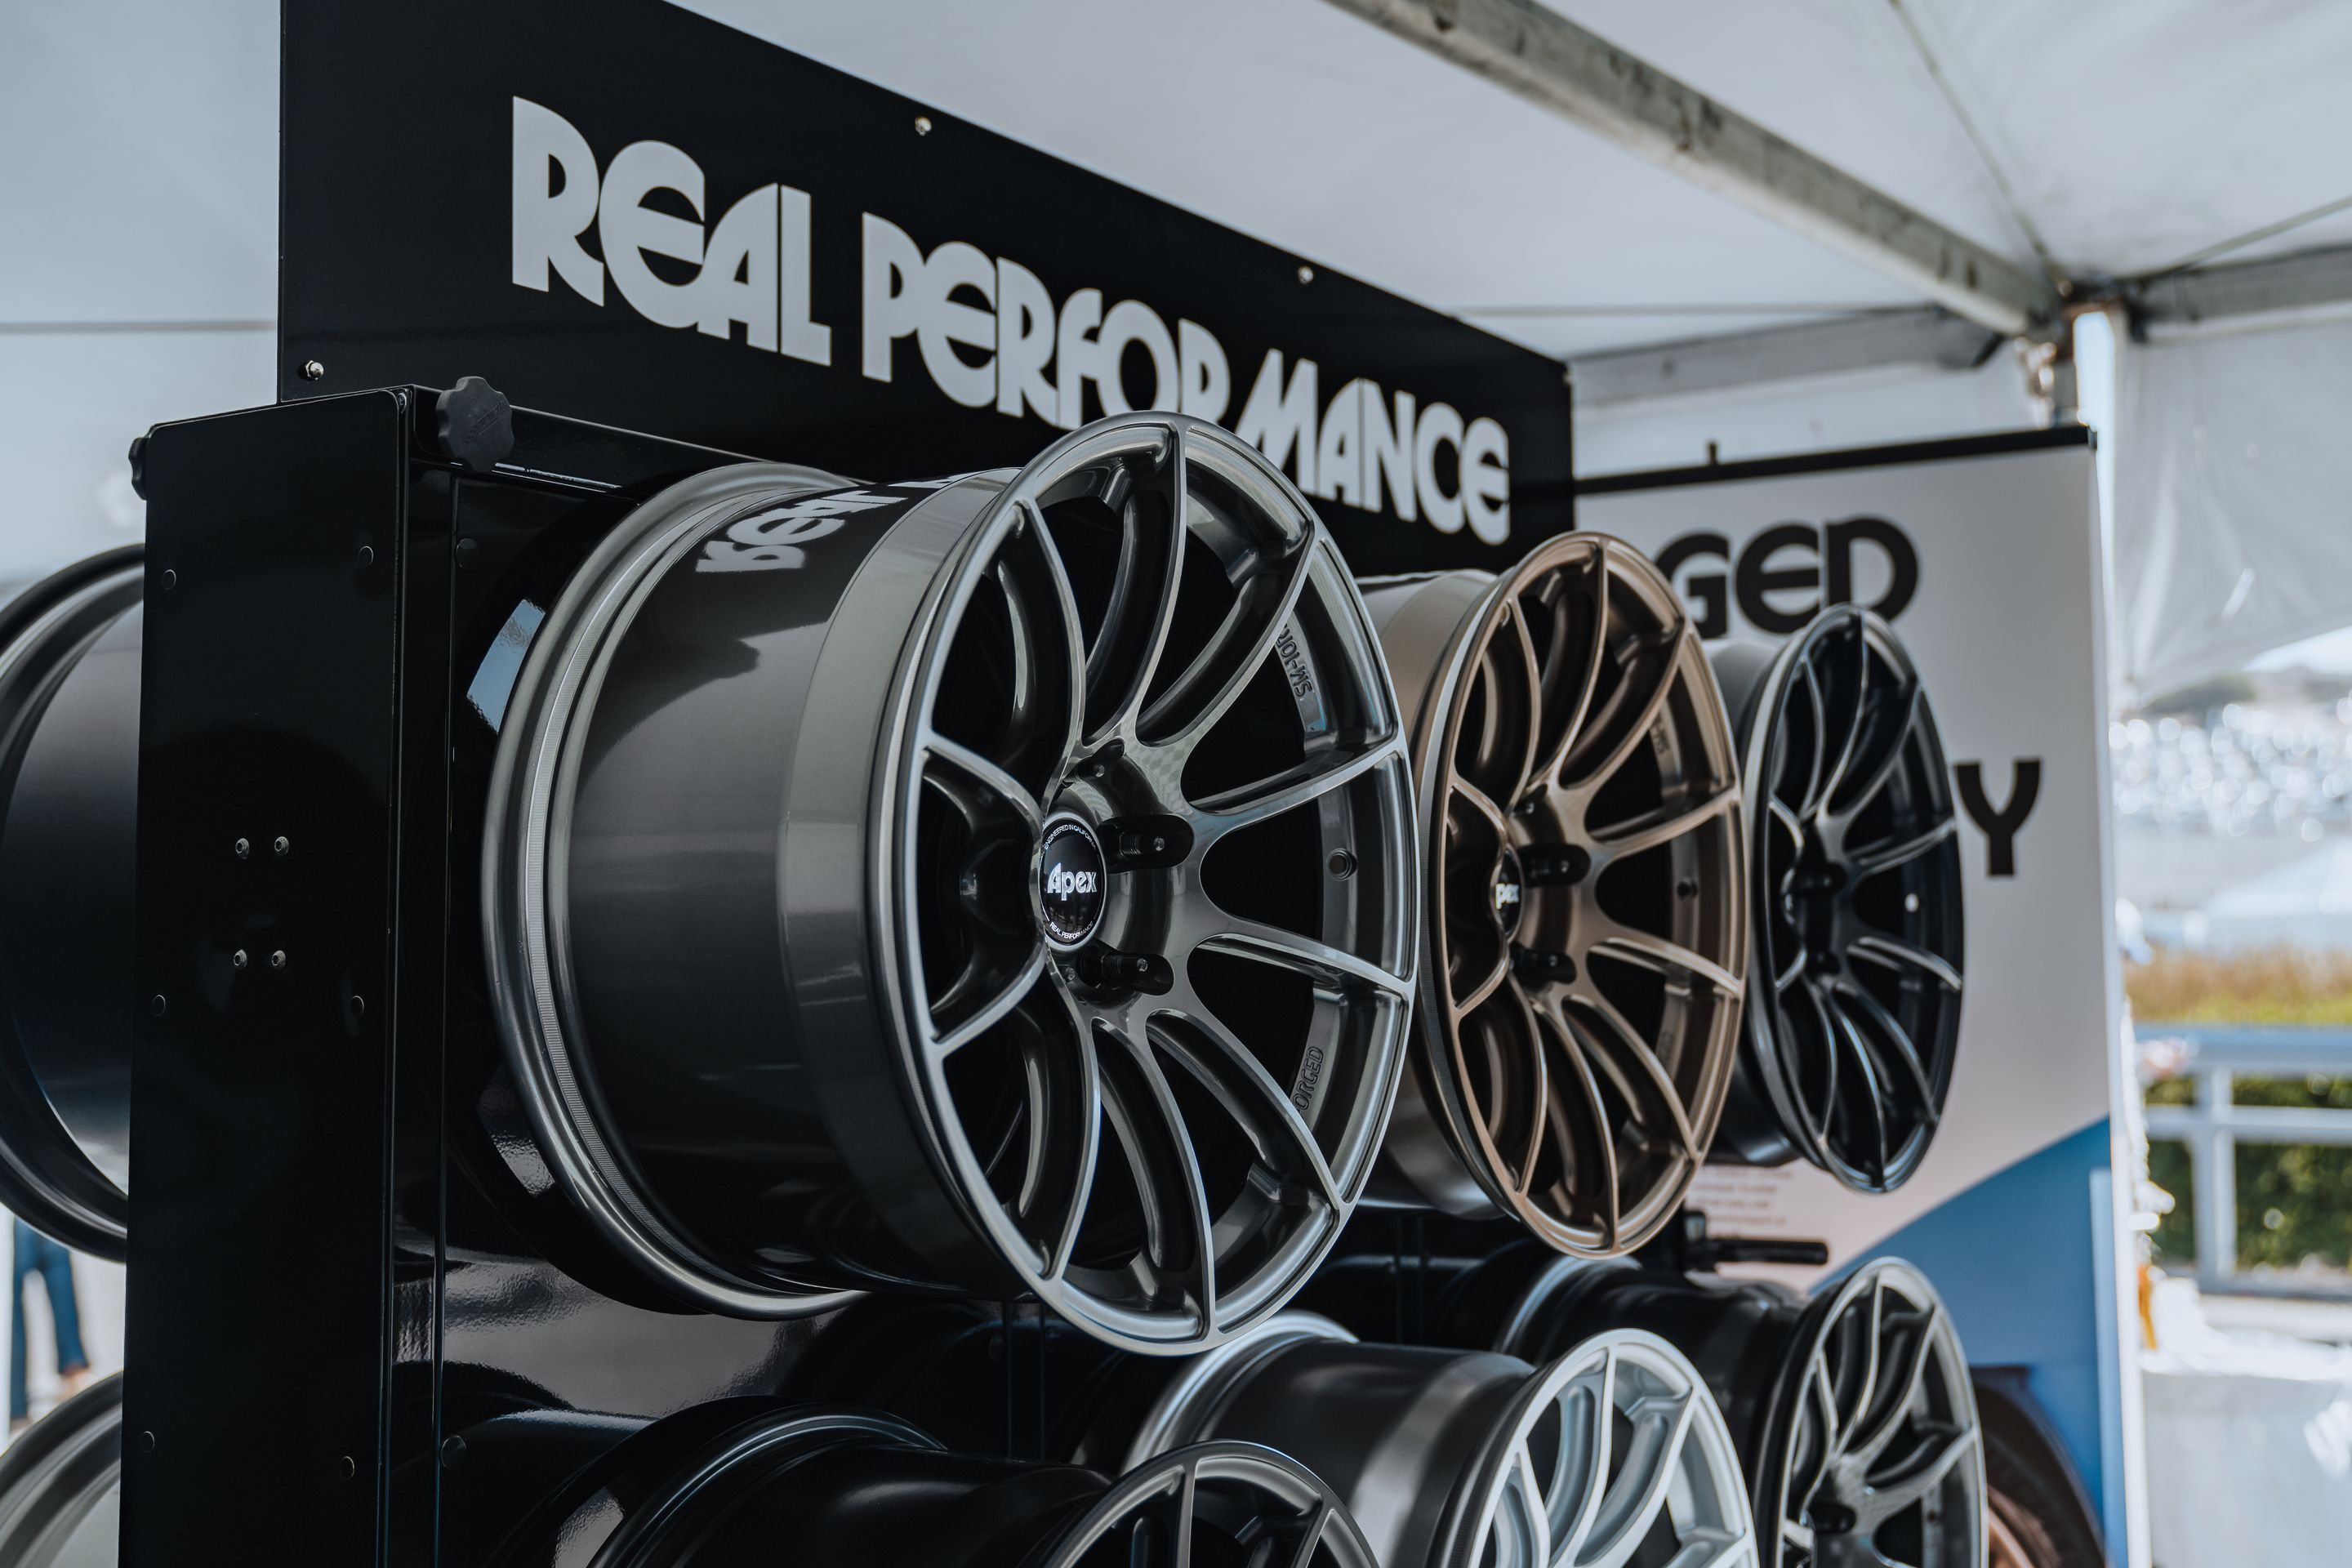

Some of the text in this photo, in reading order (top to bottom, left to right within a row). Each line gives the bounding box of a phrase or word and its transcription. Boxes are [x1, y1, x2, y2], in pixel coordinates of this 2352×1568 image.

[513, 96, 1509, 546] REAL PERFORMANCE
[1047, 862, 1098, 901] Apex
[1293, 1046, 1324, 1111] ORGED
